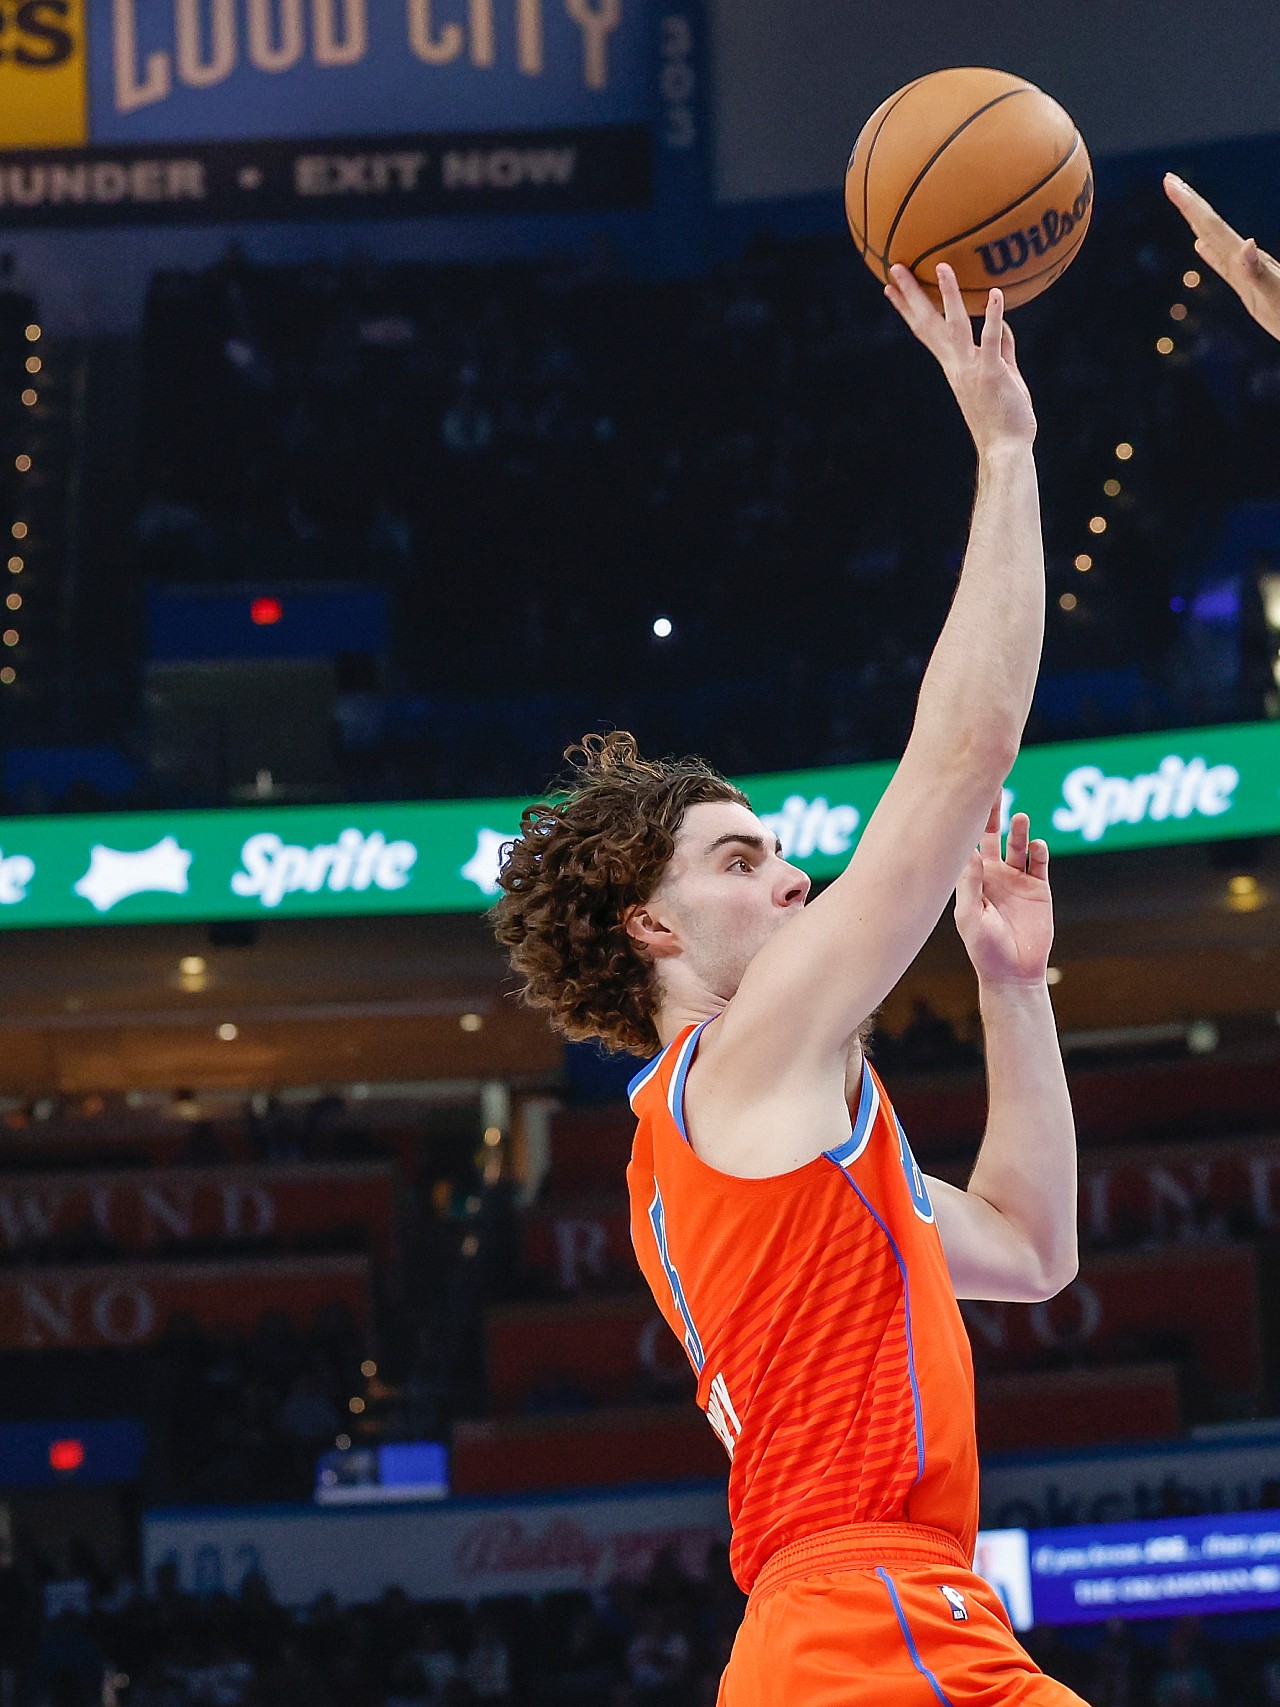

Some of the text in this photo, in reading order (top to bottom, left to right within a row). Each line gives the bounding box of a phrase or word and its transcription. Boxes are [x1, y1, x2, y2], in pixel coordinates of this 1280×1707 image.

[112, 0, 622, 112] LOUD CITY
[293, 150, 428, 198] EXIT
[441, 145, 580, 191] NOW
[1052, 755, 1240, 842] Sprite
[229, 827, 416, 907] Sprite
